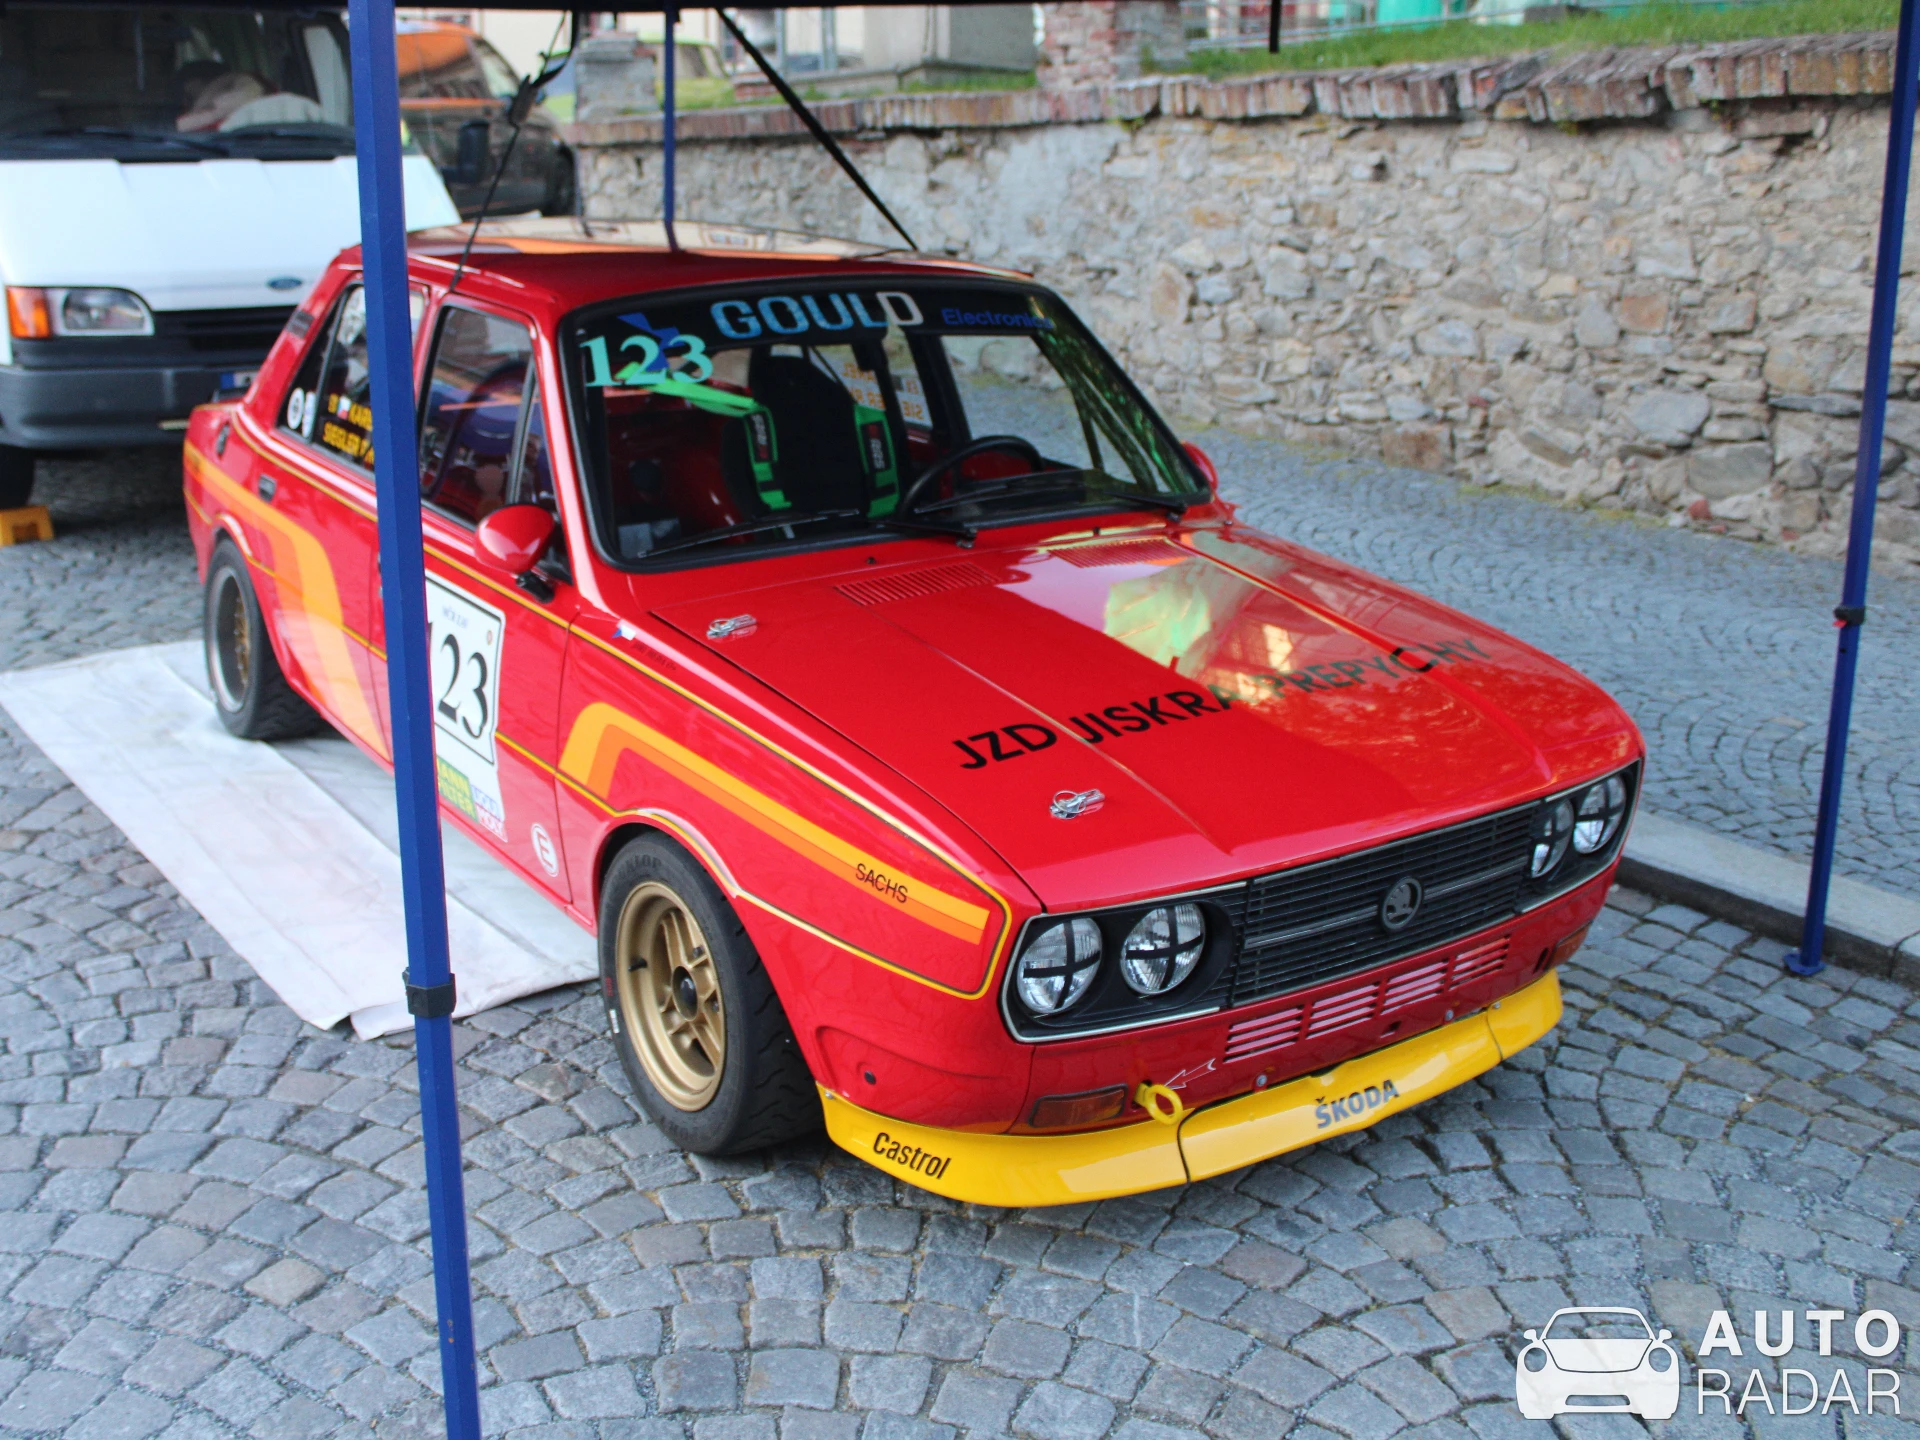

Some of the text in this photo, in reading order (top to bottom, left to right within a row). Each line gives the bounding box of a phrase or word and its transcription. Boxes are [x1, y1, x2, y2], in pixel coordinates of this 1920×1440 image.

[710, 292, 1055, 339] GOULD Electronics
[578, 334, 714, 388] 123
[428, 622, 489, 739] 23
[952, 638, 1492, 770] JZD JISKRA PREPYCHY
[854, 862, 909, 904] SACHS
[1314, 1078, 1400, 1130] ŠKODA
[873, 1131, 952, 1180] Castrol
